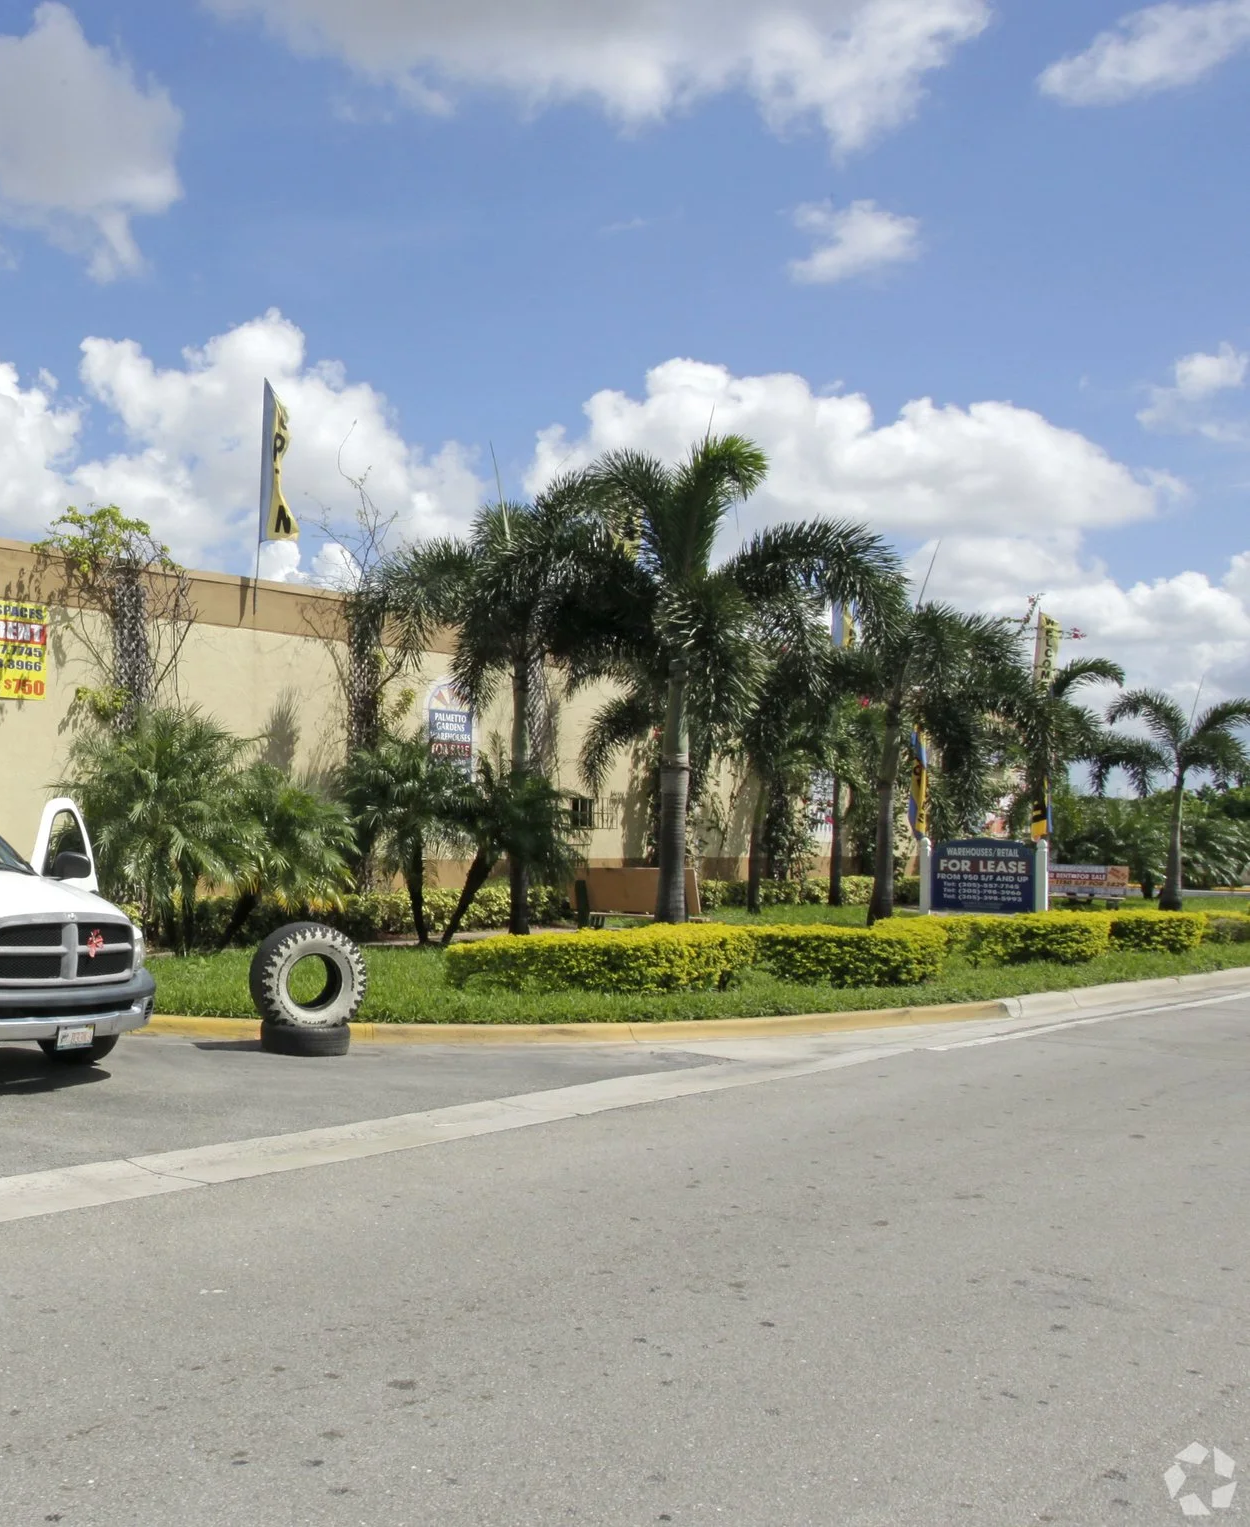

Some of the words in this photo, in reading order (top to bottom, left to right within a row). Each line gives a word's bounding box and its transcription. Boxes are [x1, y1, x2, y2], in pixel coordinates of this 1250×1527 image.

[4, 678, 45, 696] $750
[434, 712, 467, 723] PALMETTO
[436, 722, 465, 732] GARDENS
[430, 731, 471, 742] WAREHOUSES
[939, 859, 971, 872] FOR
[979, 860, 1027, 874] LEASE
[937, 873, 961, 881] FROM
[980, 874, 994, 882] S/F
